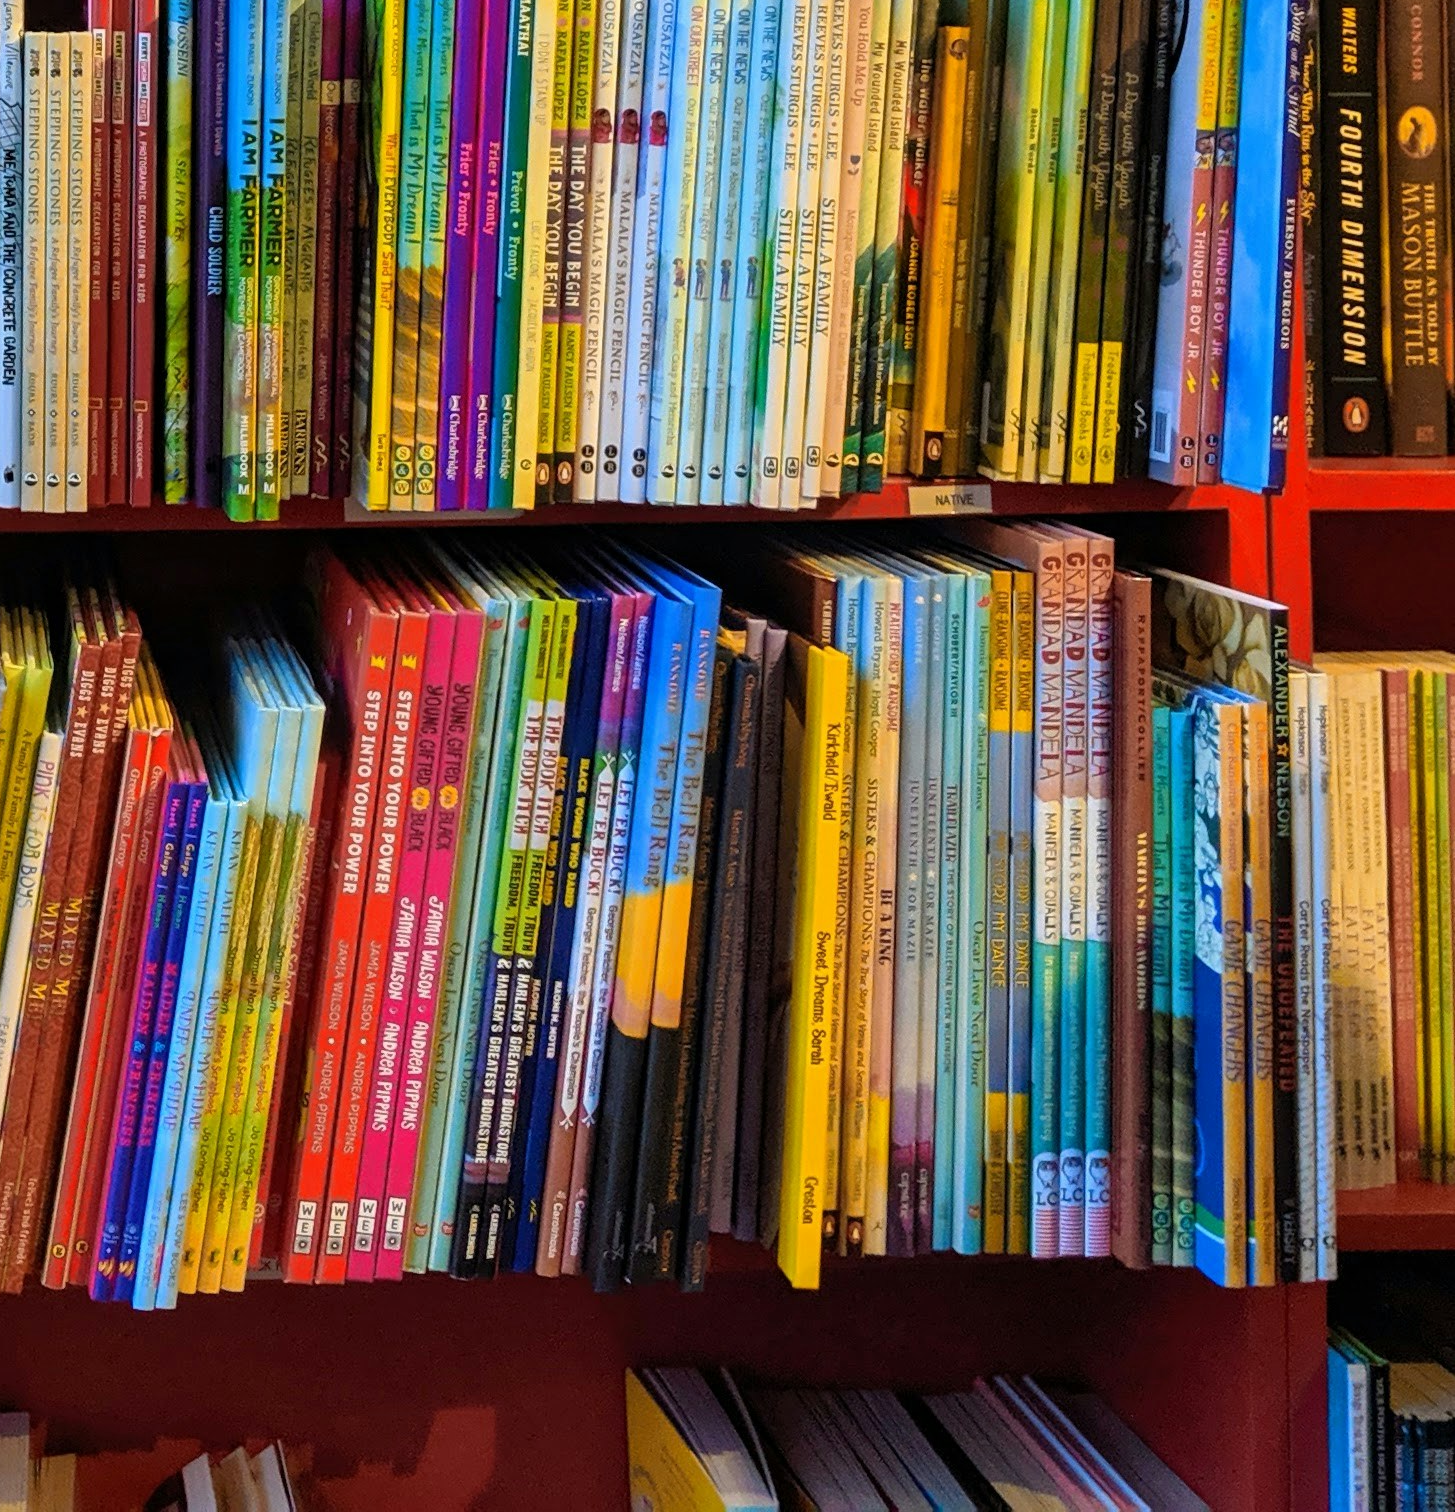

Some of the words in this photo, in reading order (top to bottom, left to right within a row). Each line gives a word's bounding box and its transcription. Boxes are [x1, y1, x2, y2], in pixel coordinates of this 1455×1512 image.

[1342, 7, 1357, 75] WALTERS
[1340, 108, 1363, 209] FOURTH
[1402, 184, 1422, 264] MASON
[1191, 230, 1209, 293] THUNDER
[1340, 219, 1367, 366] DIMENSION
[1187, 297, 1204, 335] BOY
[1405, 269, 1424, 367] BUTTLE
[1185, 341, 1200, 364] JR.
[936, 494, 974, 505] NATIVE
[1040, 556, 1061, 665] GRANDAD
[395, 690, 412, 732] STEP
[1273, 624, 1289, 744] ALEXANDER
[388, 734, 407, 778] INTO
[1039, 673, 1060, 780] MANDELA
[382, 782, 402, 828] YOUR
[1274, 761, 1290, 837] NELSON
[374, 832, 394, 894] POWER
